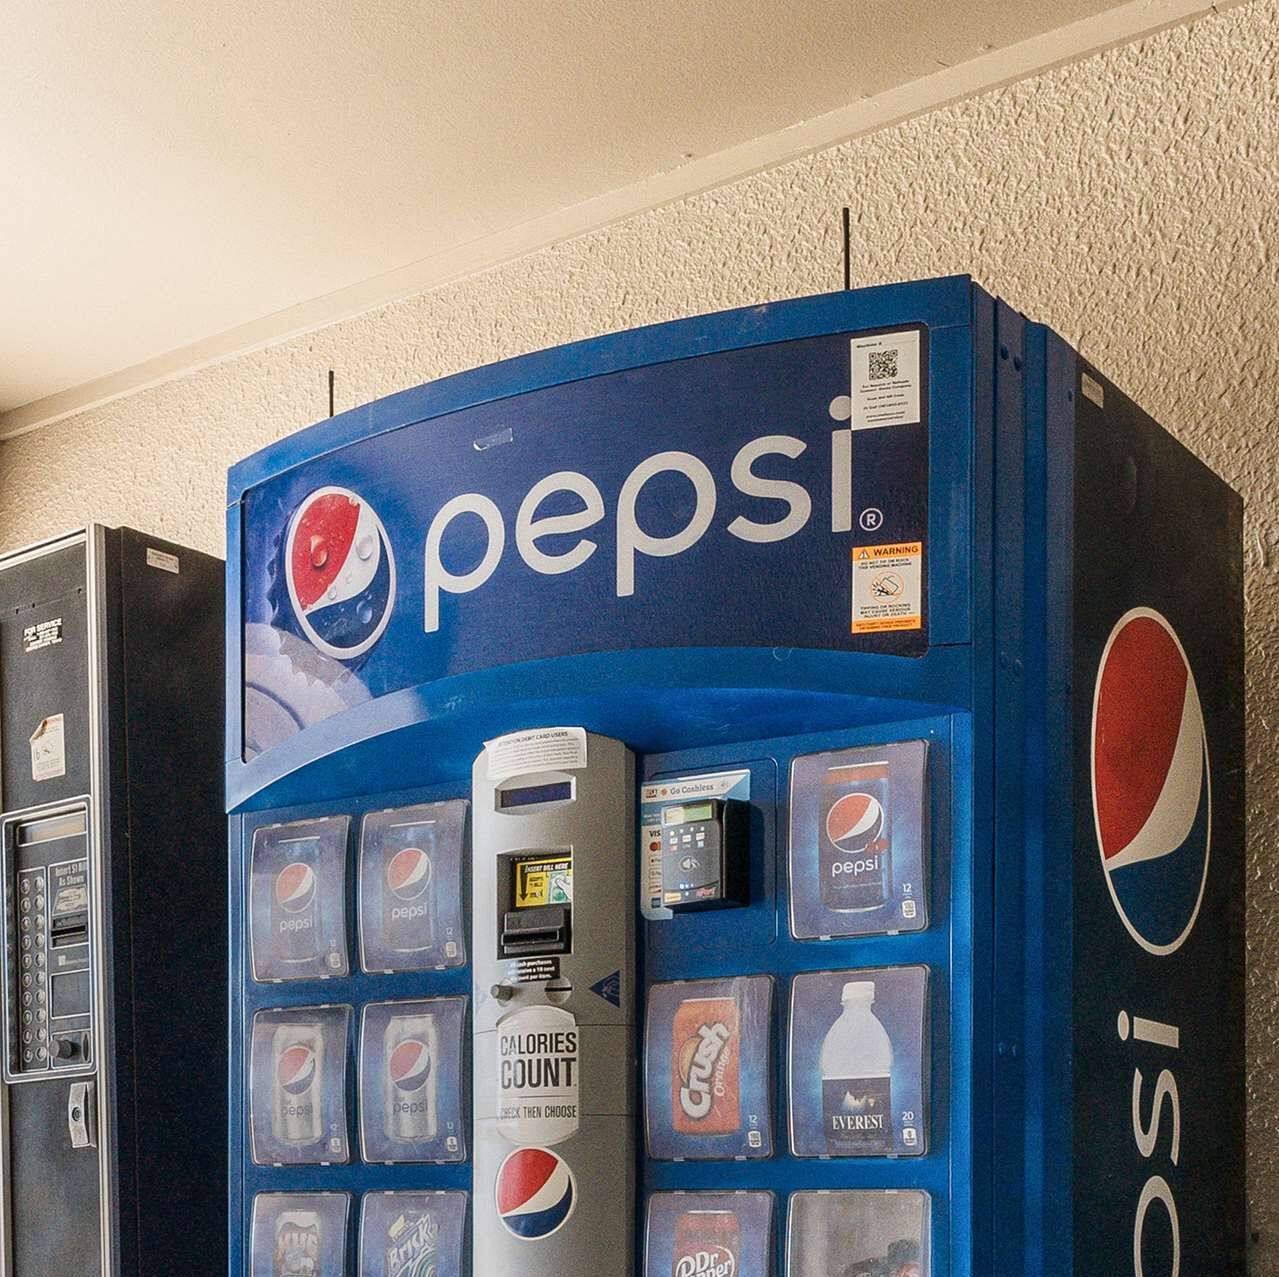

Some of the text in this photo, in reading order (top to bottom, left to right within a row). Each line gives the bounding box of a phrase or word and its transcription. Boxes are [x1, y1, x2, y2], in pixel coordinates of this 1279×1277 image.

[424, 396, 852, 632] pepsi
[873, 545, 919, 556] WARNING
[23, 618, 62, 637] FOR SERVICE
[832, 855, 879, 878] pepsi
[902, 883, 912, 893] 12
[391, 902, 427, 921] pepsi
[279, 915, 313, 933] pepsi
[501, 1032, 577, 1056] CALORIES
[681, 1023, 731, 1119] Crush
[281, 1102, 314, 1118] pepsi
[392, 1101, 428, 1118] pepsi
[523, 1106, 542, 1119] THEN
[544, 1104, 577, 1119] CHOOSE
[902, 1111, 914, 1121] 20
[832, 1114, 884, 1130] EVEREST
[696, 1251, 719, 1274] Dr
